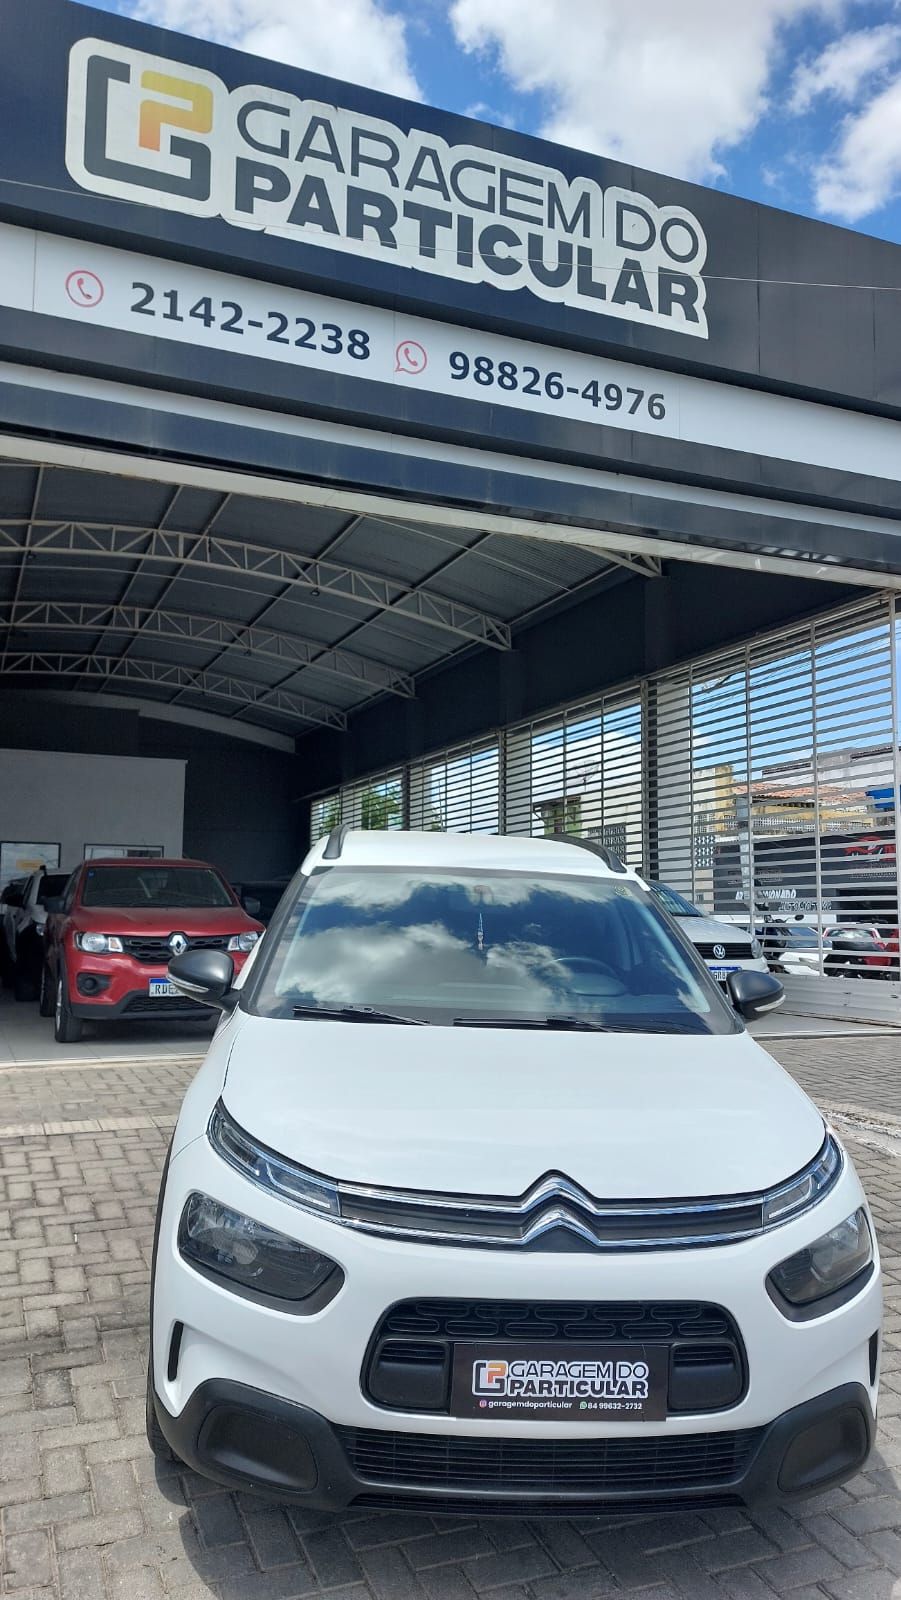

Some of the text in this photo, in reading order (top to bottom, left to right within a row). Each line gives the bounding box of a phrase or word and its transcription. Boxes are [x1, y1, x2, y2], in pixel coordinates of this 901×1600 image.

[237, 100, 699, 264] GARAGEM DO
[234, 156, 700, 324] PARTICULAR
[130, 281, 371, 361] 2142-2238
[448, 350, 667, 421] 98826-4976
[488, 1400, 573, 1410] garagemdoparticular
[509, 1379, 647, 1397] PARTICULAR
[510, 1362, 648, 1379] GARAGEM DO
